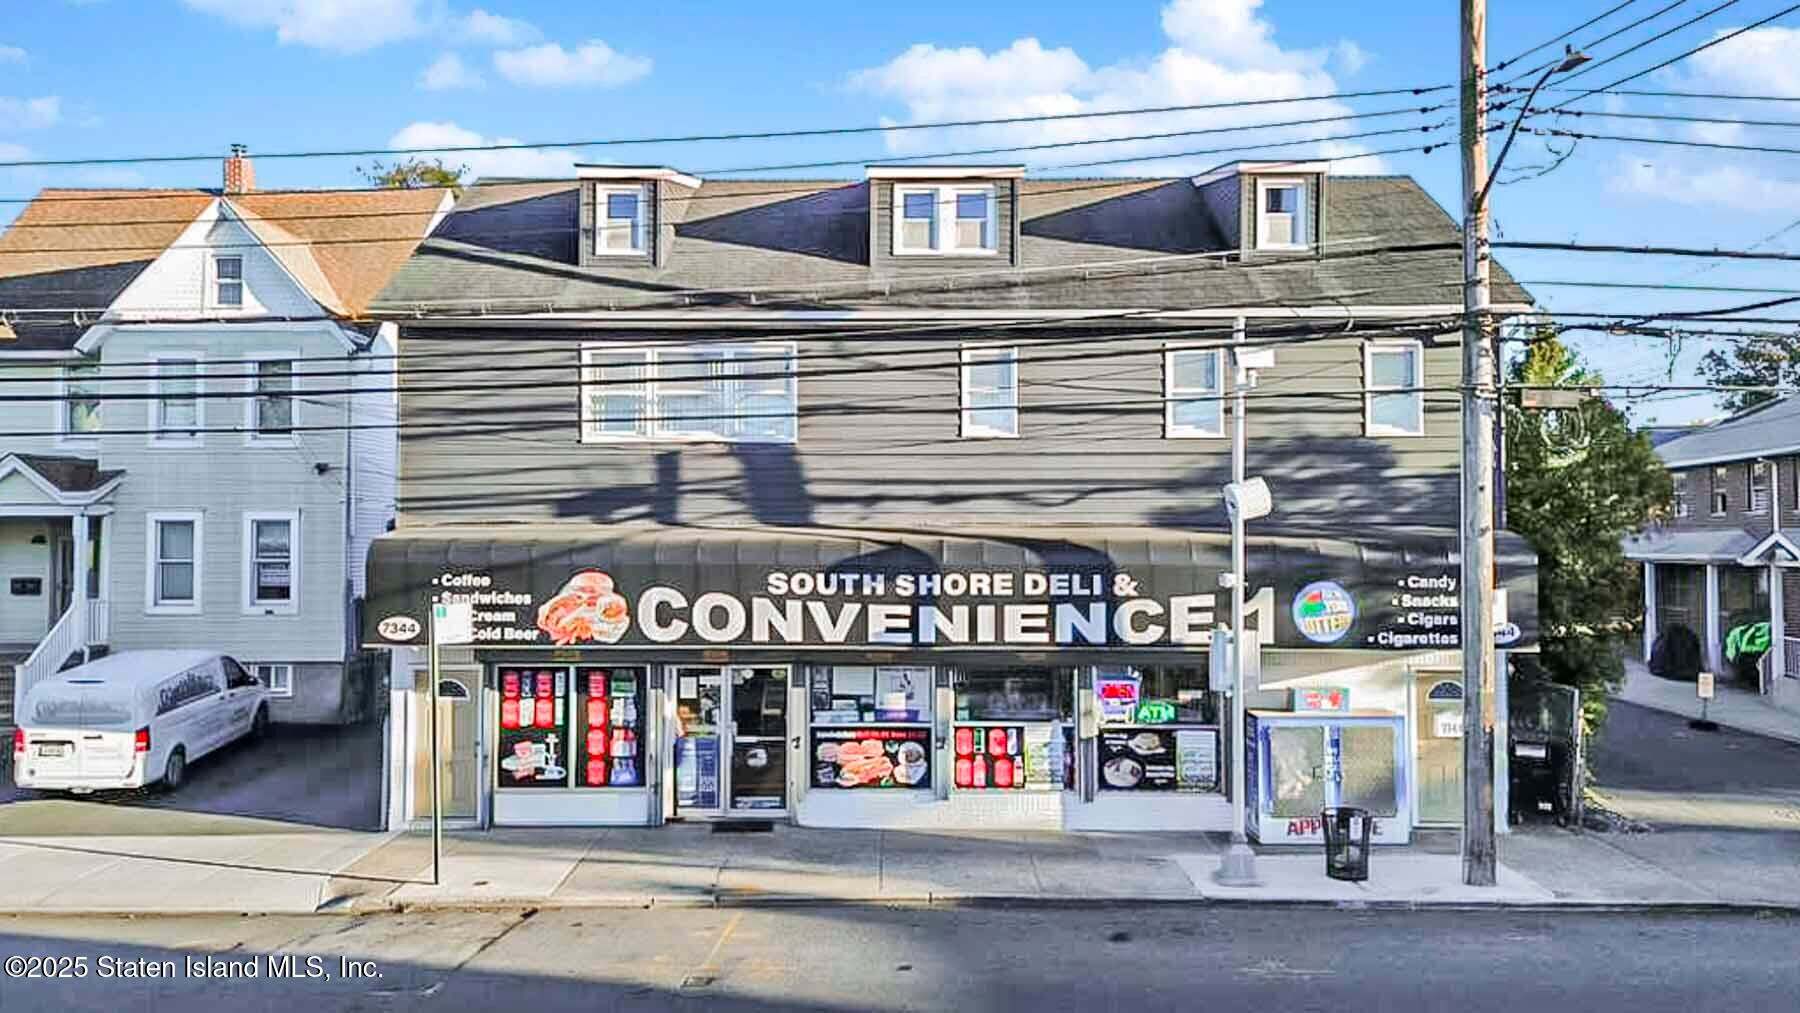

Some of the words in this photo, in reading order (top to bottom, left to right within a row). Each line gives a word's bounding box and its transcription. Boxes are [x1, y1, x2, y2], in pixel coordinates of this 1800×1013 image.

[440, 572, 492, 587] Coffee
[767, 572, 885, 596] SOUTH
[895, 572, 1014, 596] SHORE
[1024, 573, 1101, 596] DELI
[1112, 573, 1140, 597] &
[1406, 575, 1457, 590] Candy
[441, 591, 532, 605] Sandwiches
[1400, 593, 1460, 608] Snacks
[637, 585, 1217, 645] CONVENIENCE
[1406, 612, 1459, 628] Cigars
[382, 622, 417, 635] 7344
[503, 627, 540, 641] Beer
[1376, 631, 1460, 646] Cigarettes
[1137, 702, 1175, 721] ATM
